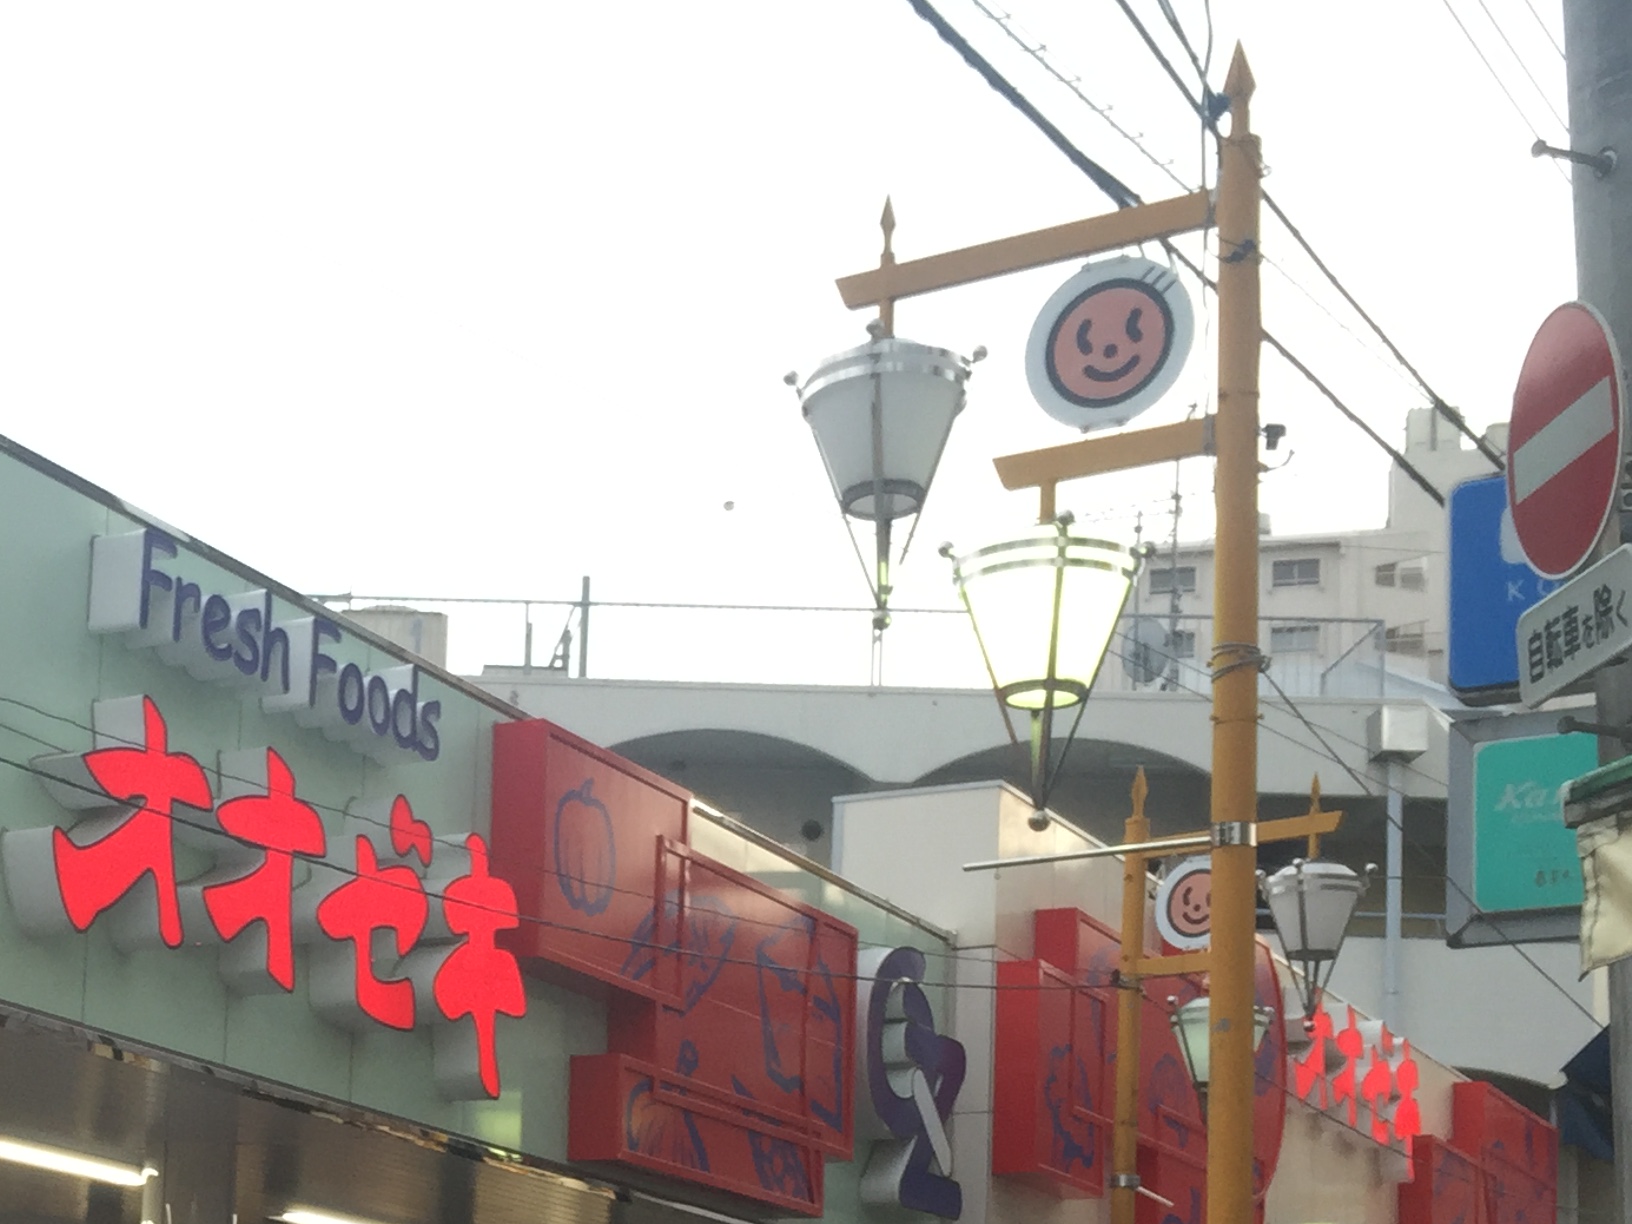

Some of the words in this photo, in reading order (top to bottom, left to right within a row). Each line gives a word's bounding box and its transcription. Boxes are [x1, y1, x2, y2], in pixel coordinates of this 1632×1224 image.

[139, 528, 290, 694] Fresh
[309, 617, 441, 761] Foods
[1528, 583, 1628, 684] 自転車を除く
